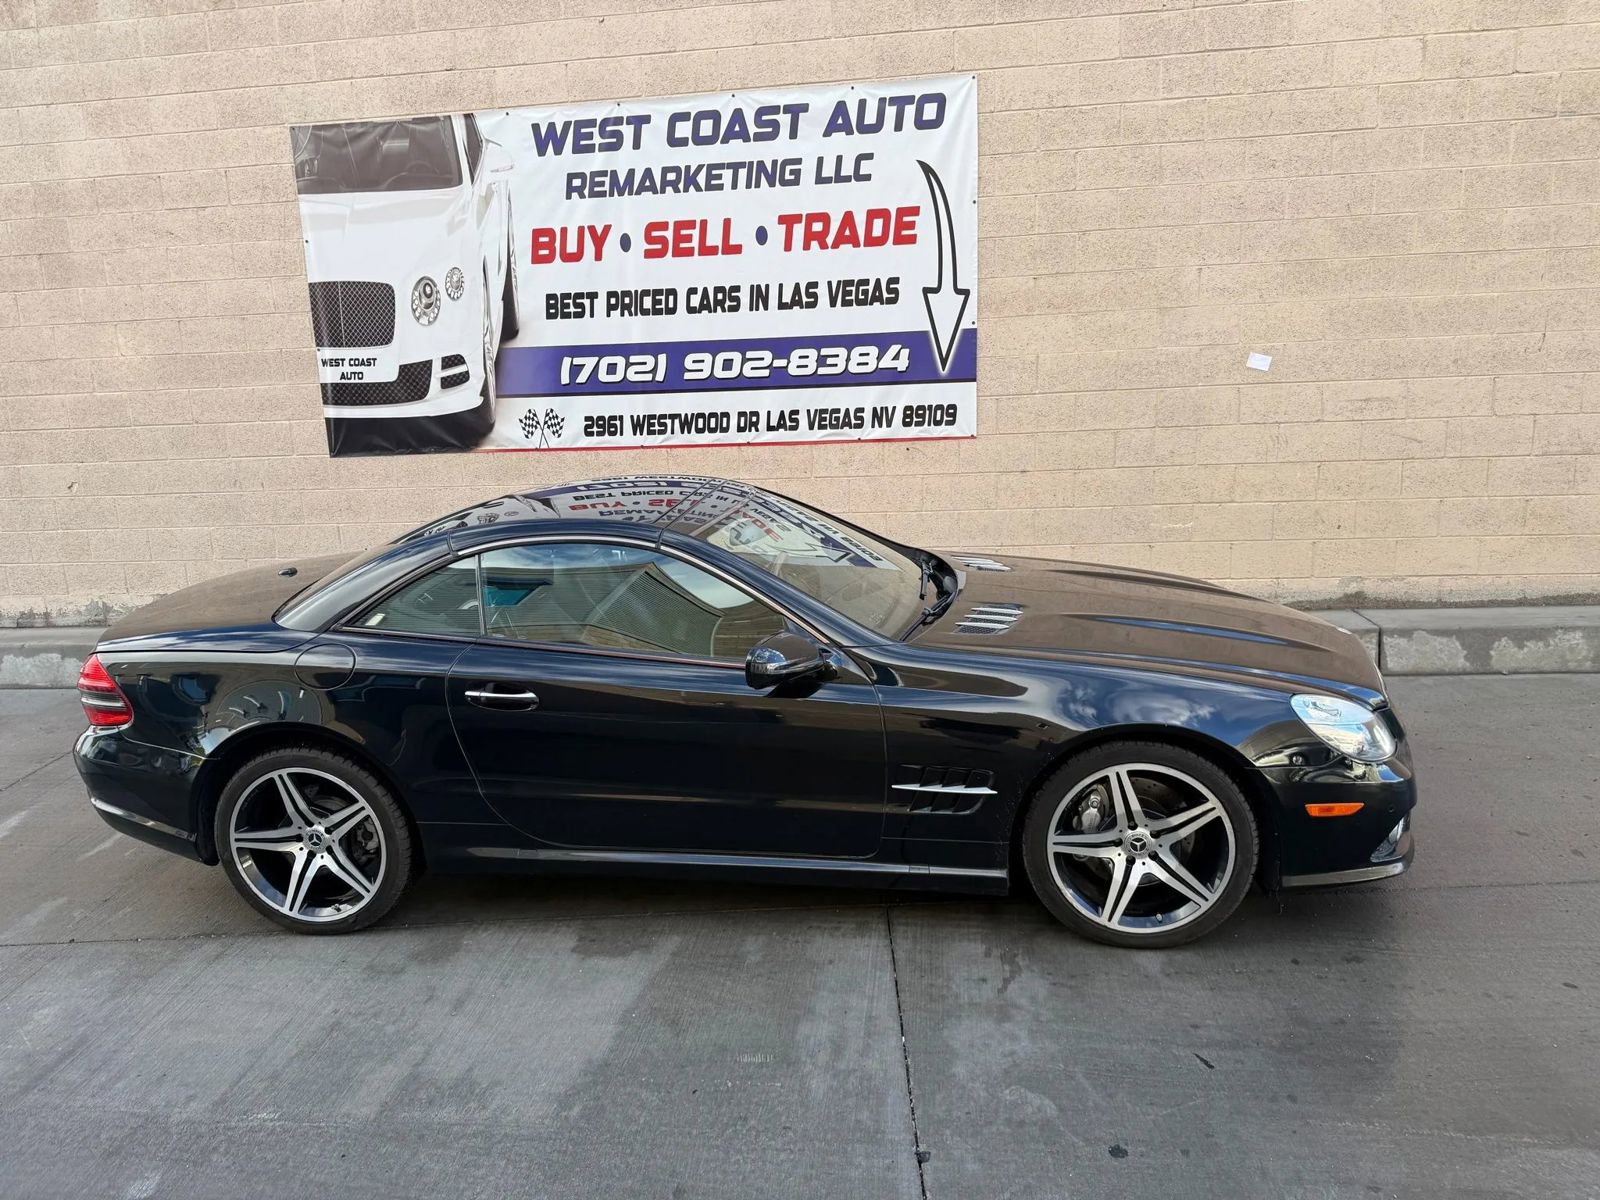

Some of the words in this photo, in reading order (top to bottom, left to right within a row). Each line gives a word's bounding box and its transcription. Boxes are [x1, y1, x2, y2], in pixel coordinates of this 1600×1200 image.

[531, 114, 652, 157] WEST
[666, 103, 810, 148] COAST
[822, 92, 947, 137] AUTO
[565, 157, 803, 200] REMARKETING
[815, 152, 874, 185] LLC
[531, 224, 612, 264] BUY
[643, 218, 743, 259] SELL
[777, 206, 920, 252] TRADE
[545, 291, 598, 320] BEST
[606, 287, 678, 318] PRICED
[686, 284, 741, 314] CARS
[749, 283, 770, 312] IN
[777, 281, 819, 310] LAS
[827, 276, 900, 308] VEGAS
[321, 358, 346, 367] WEST
[348, 358, 377, 367] COAST
[340, 371, 364, 380] AUTO
[560, 353, 667, 386] (702)
[683, 344, 910, 381] 902-8384
[584, 414, 624, 437] 2961
[630, 411, 731, 436] WESTWOOD
[737, 410, 760, 433] DR
[766, 409, 800, 432] LAS
[807, 407, 865, 431] VEGAS
[871, 405, 896, 429] NV
[902, 404, 957, 428] 89109
